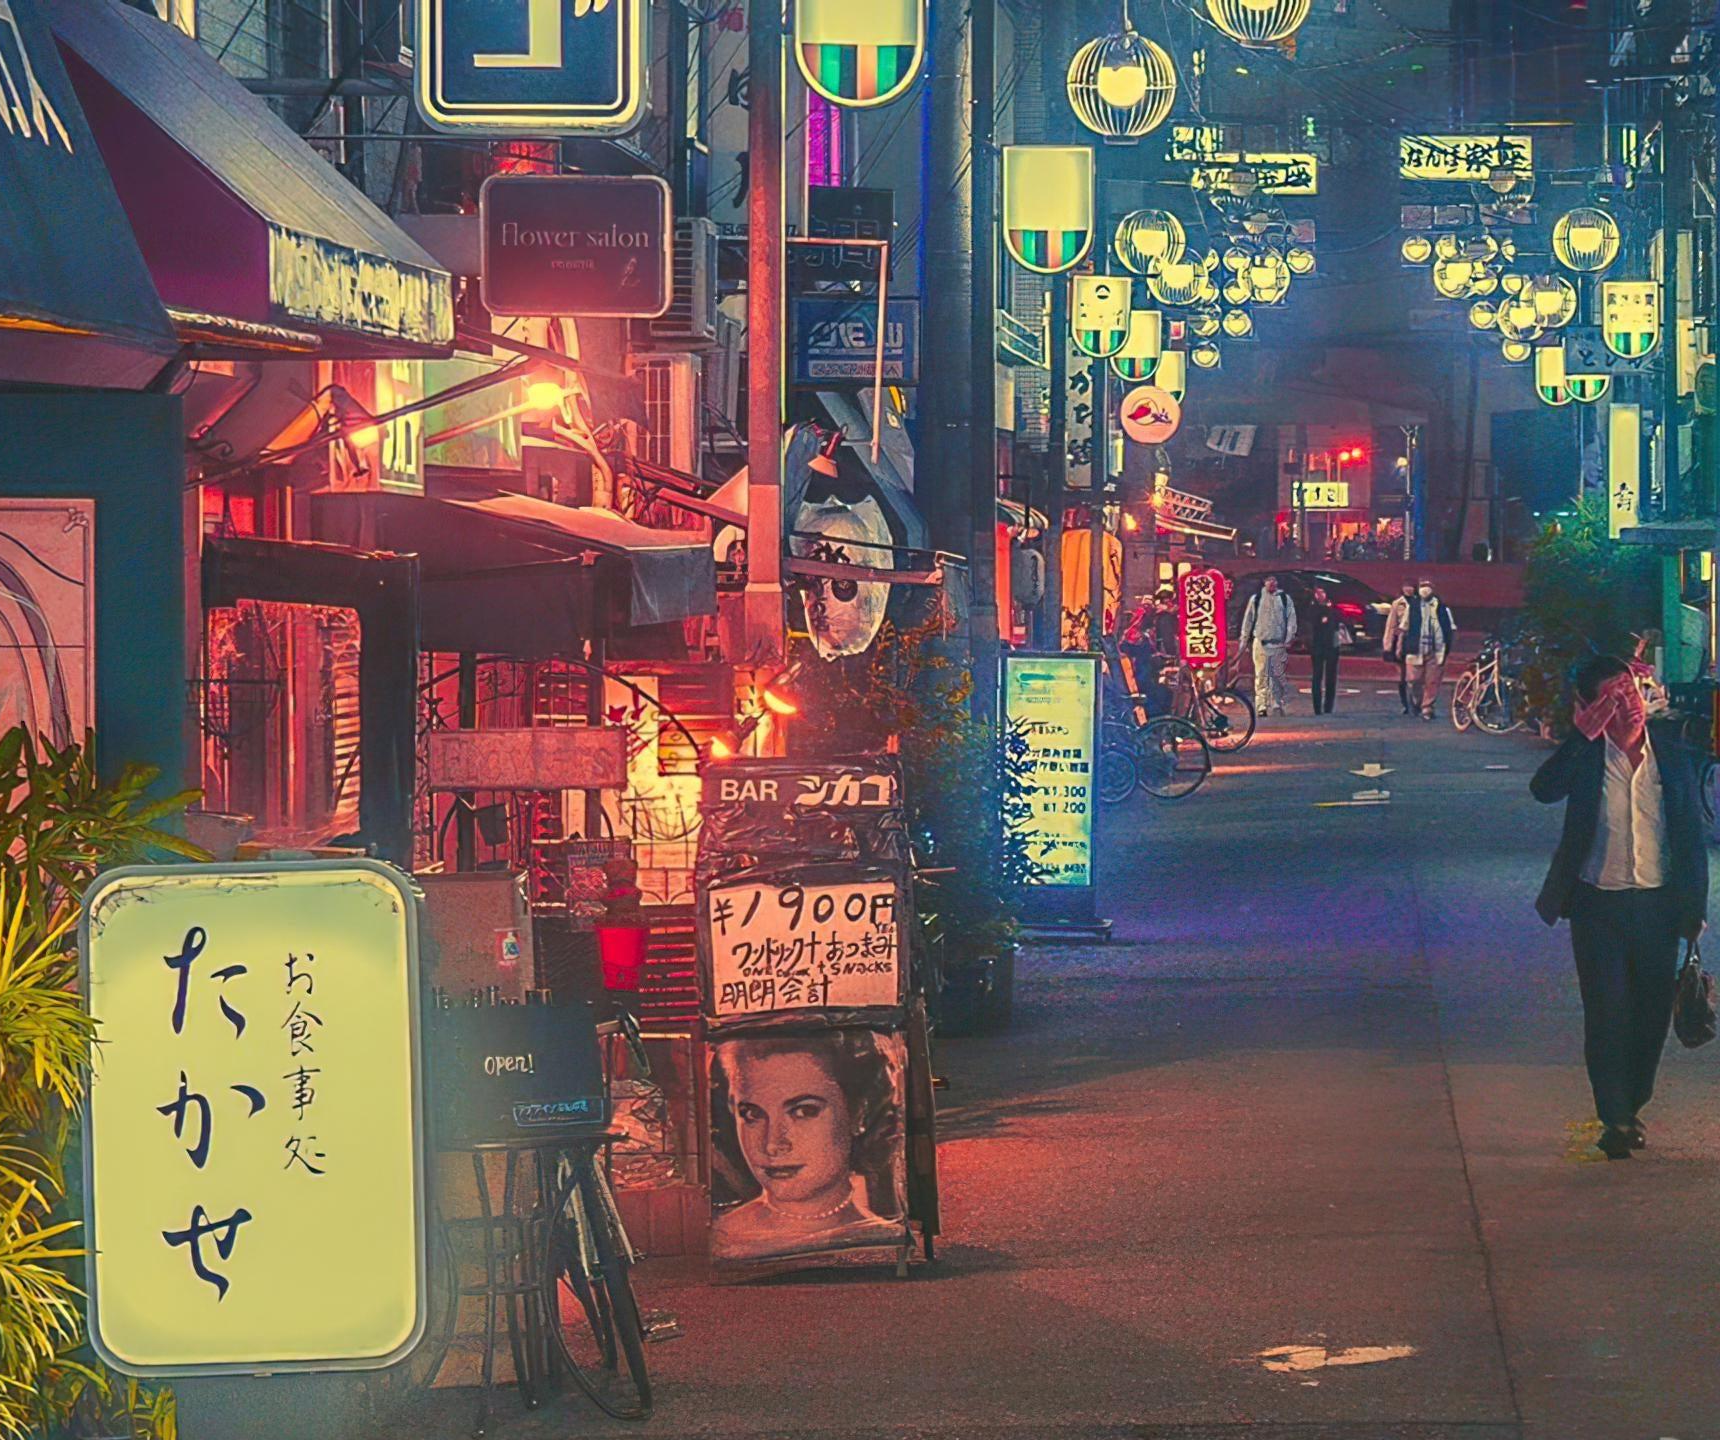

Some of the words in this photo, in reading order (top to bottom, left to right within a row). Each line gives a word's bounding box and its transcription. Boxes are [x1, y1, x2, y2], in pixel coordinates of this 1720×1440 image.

[584, 223, 650, 248] salon
[718, 779, 780, 802] BAR
[719, 976, 834, 1005] 明朗会計
[282, 952, 327, 1175] お食事処
[156, 926, 267, 1303] たかせ
